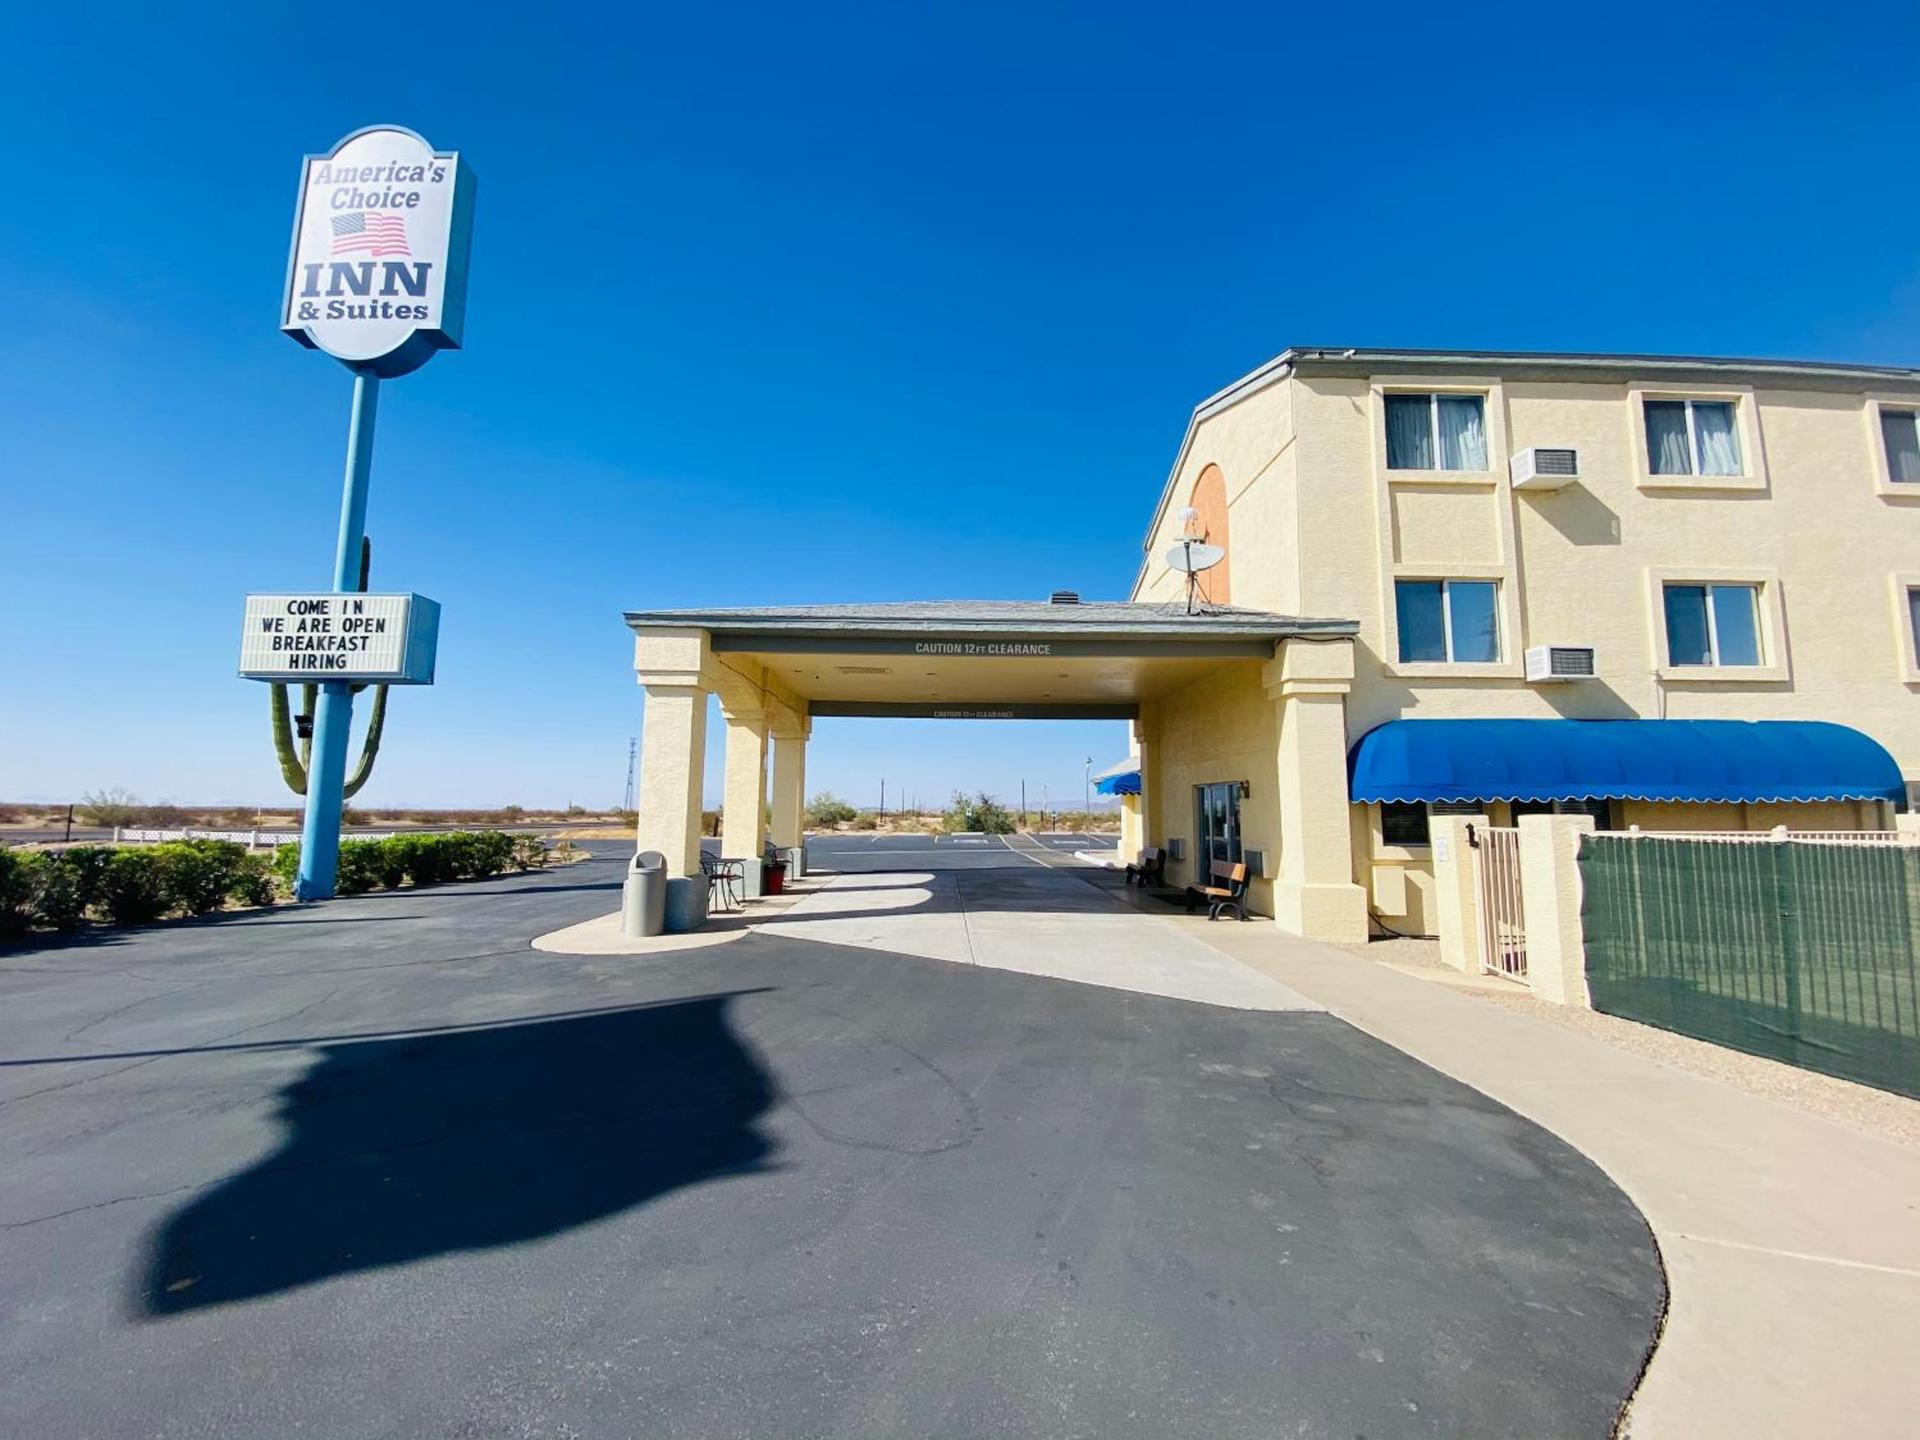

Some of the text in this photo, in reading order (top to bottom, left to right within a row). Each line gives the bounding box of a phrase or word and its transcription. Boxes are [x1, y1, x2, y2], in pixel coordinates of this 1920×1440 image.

[314, 161, 446, 184] America's
[330, 186, 420, 209] Choice
[300, 262, 432, 297] INN
[298, 299, 428, 320] & Suites
[287, 600, 363, 615] COME IN
[262, 618, 386, 633] WE ARE OPEN
[272, 636, 369, 651] BREAKFAST
[916, 643, 962, 653] CAUTION
[988, 645, 1050, 655] CLEARANCE
[289, 654, 347, 669] HIRING
